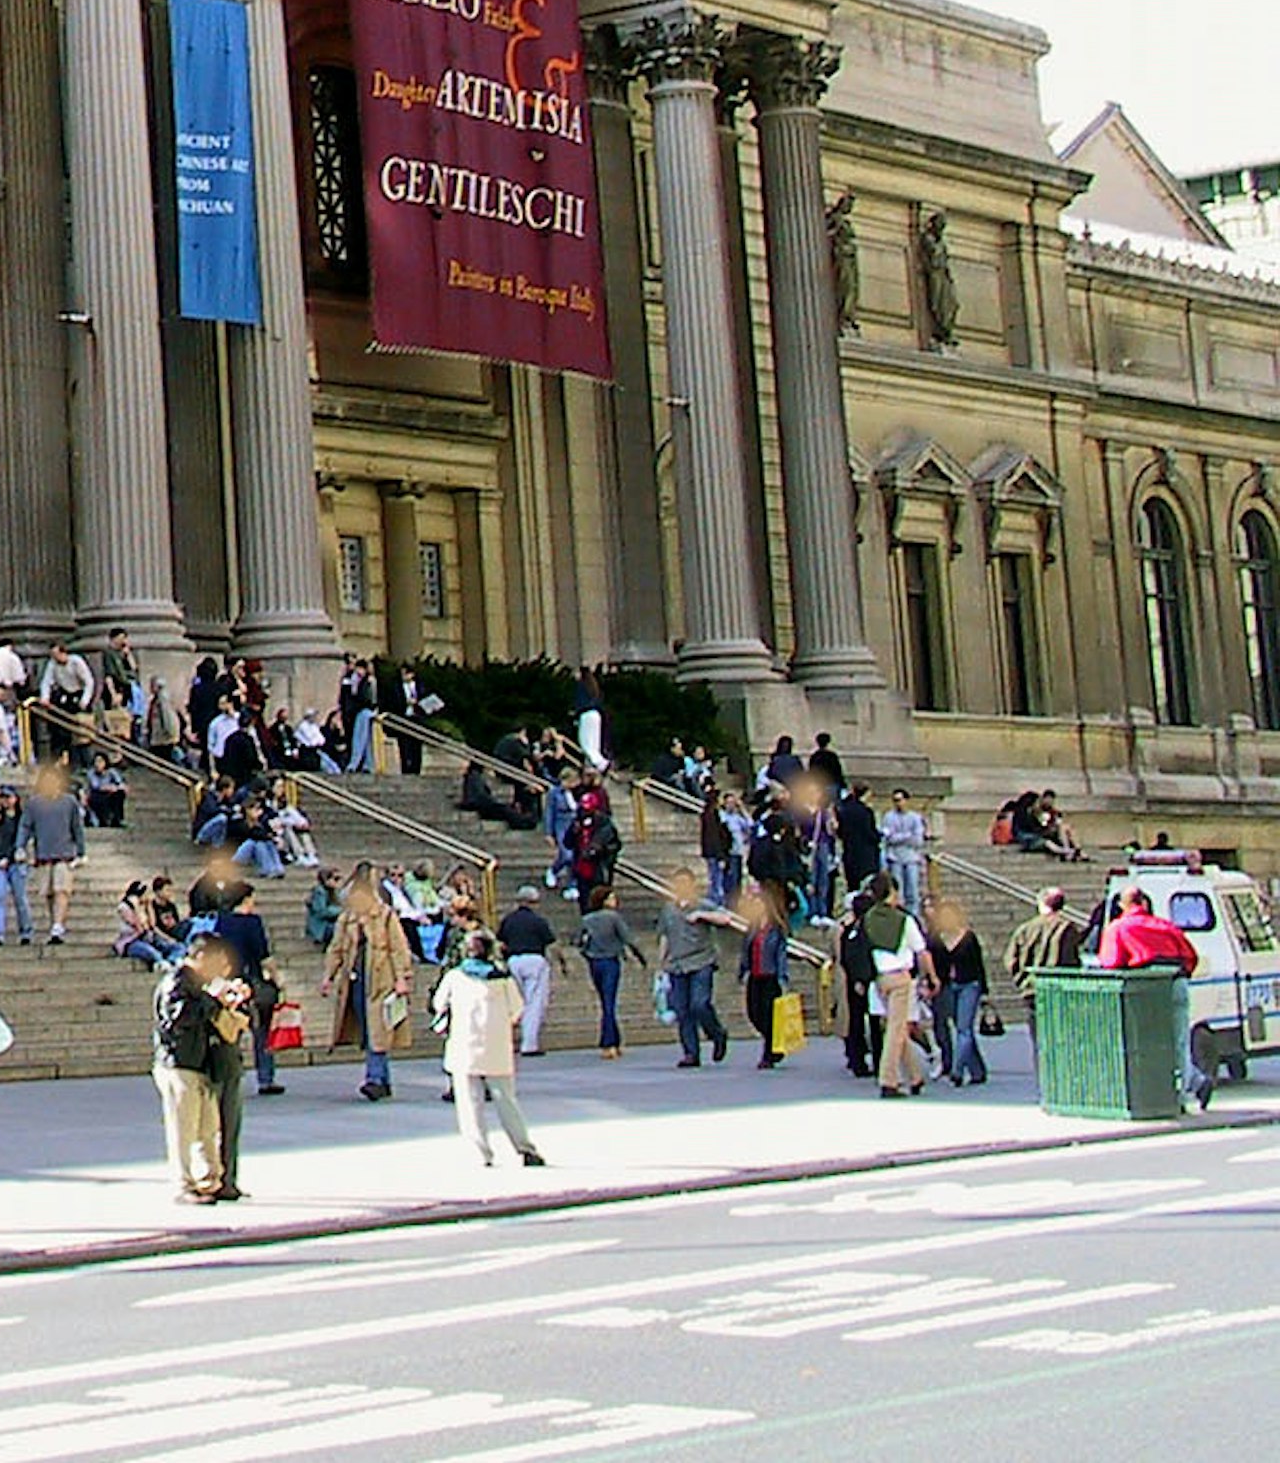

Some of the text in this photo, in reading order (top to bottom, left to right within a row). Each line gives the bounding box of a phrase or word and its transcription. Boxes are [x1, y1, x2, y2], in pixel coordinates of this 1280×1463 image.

[372, 68, 584, 144] Daughter ARTEMISIA
[380, 155, 586, 238] GENTILESCHI
